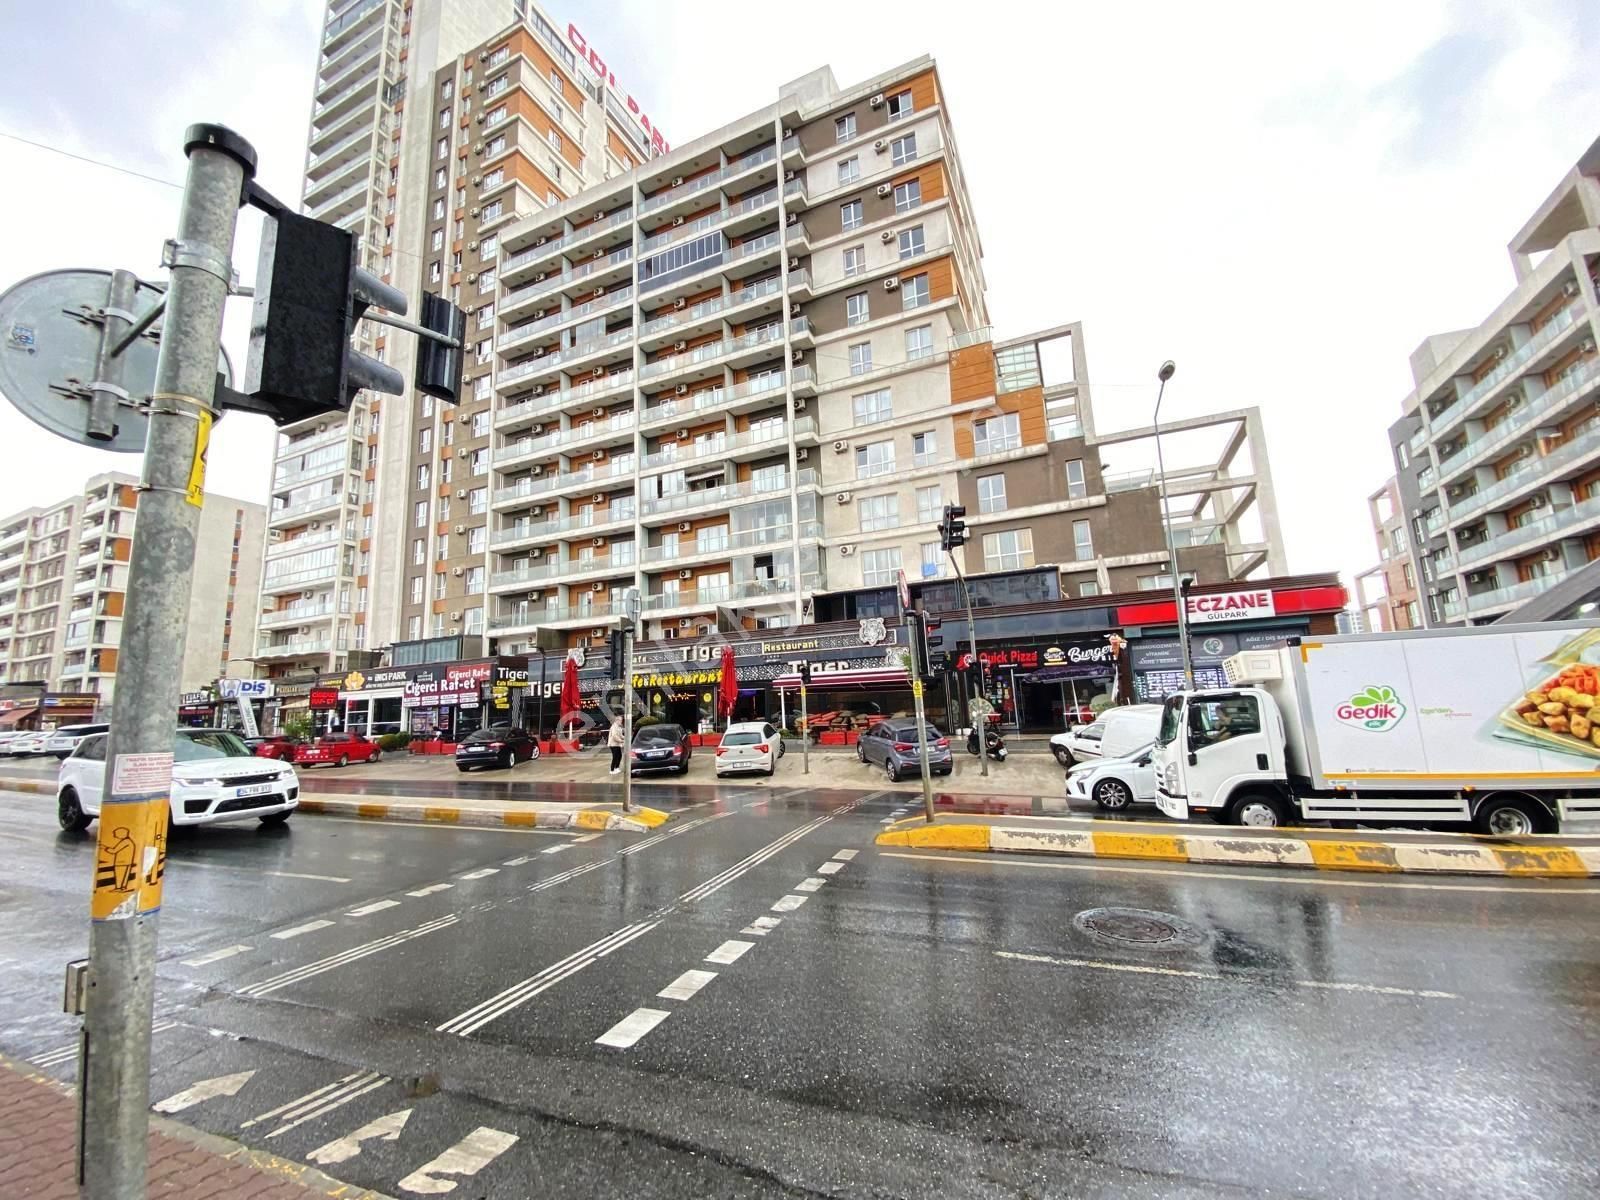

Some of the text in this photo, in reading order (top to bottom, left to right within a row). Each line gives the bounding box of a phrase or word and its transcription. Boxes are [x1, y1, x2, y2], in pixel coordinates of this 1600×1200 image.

[1187, 593, 1269, 613] ECZANE
[1207, 610, 1248, 620] GÜLPARK
[764, 640, 819, 652] Restaurant
[632, 655, 647, 663] afe
[680, 645, 722, 662] Tige
[979, 652, 1008, 664] Quick
[1010, 650, 1038, 662] Pizza
[388, 671, 407, 681] PARK
[472, 668, 491, 677] Raf-e
[497, 667, 528, 681] Tiger
[405, 680, 438, 696] Ciğerci
[440, 677, 475, 692] Raf-et
[1337, 704, 1397, 720] Gedik
